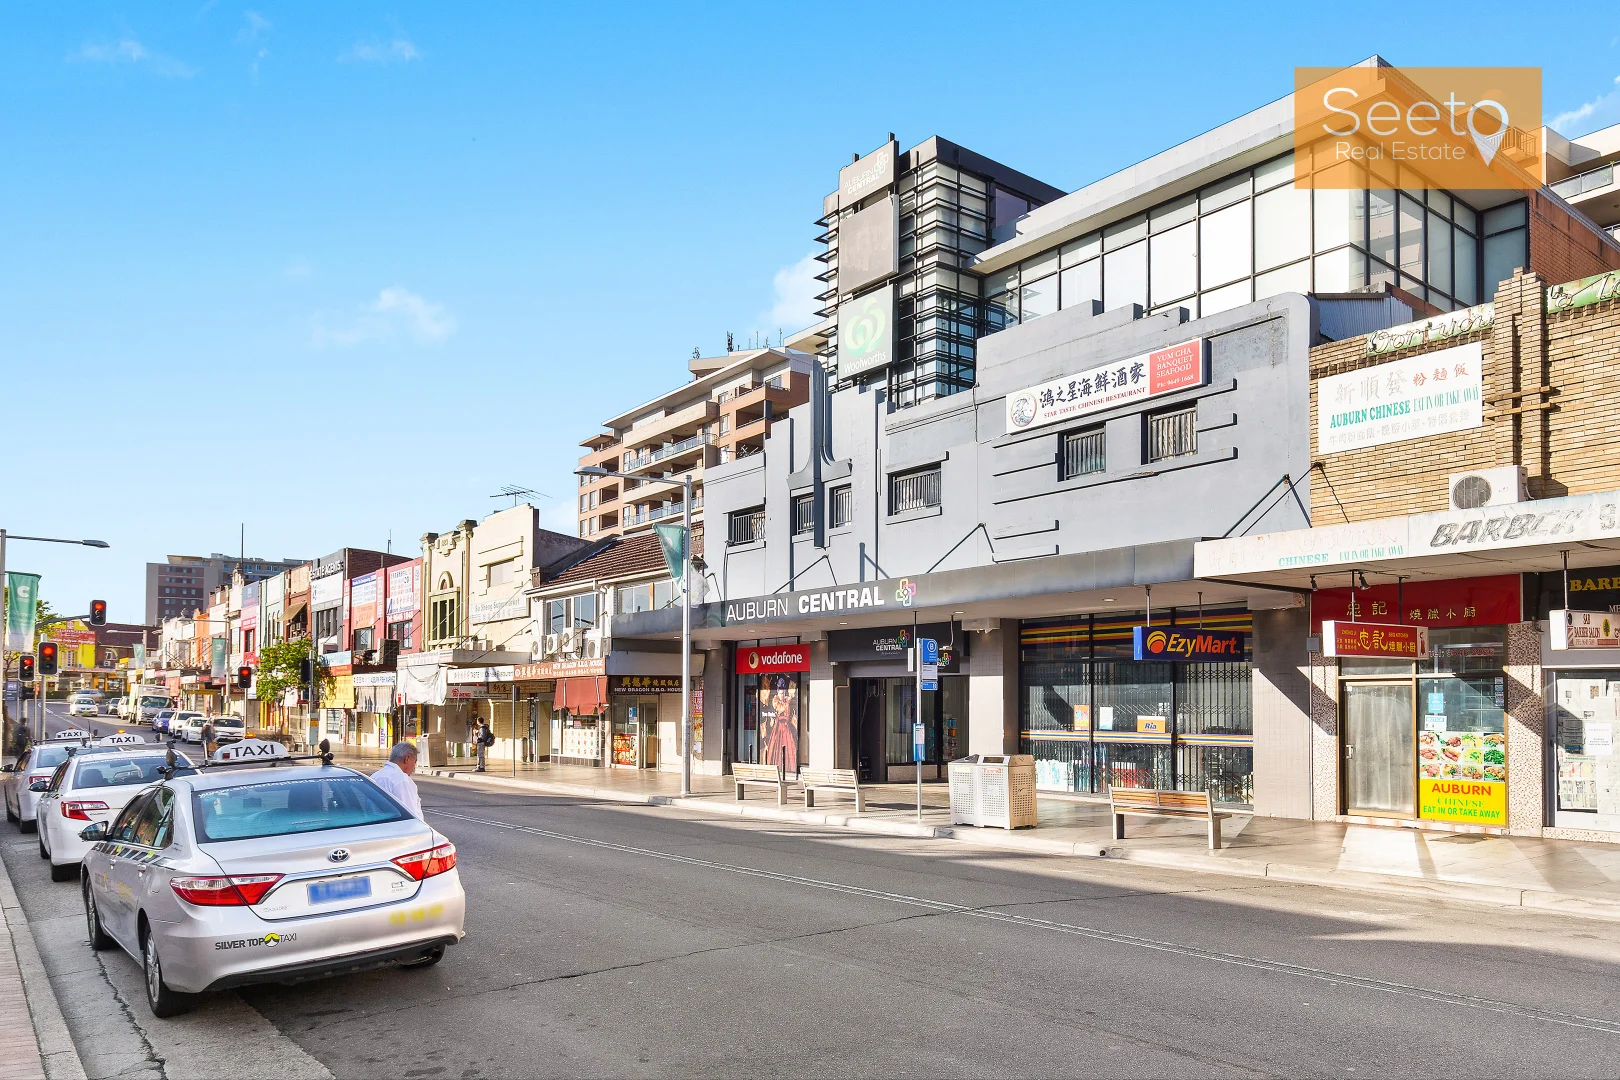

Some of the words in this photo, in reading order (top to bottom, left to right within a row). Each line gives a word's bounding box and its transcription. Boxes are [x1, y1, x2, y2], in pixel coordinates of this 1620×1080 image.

[846, 174, 880, 195] CENTRAL
[843, 350, 886, 374] Woolworths
[1156, 352, 1173, 363] YUM
[1175, 347, 1191, 358] CHA
[1157, 354, 1194, 370] BANQUET
[1156, 363, 1192, 378] SEAFOOD
[1039, 361, 1146, 408] 鴻之星海鮮酒家
[1043, 410, 1058, 419] STAR
[1059, 406, 1077, 415] TASTE
[1078, 399, 1105, 412] CHINESE
[1105, 387, 1147, 402] RESTAURANT
[1329, 407, 1368, 429] AUBURN
[1369, 399, 1411, 421] CHINESE
[1278, 553, 1329, 567] CHINESE
[1359, 549, 1369, 560] OR
[1370, 547, 1385, 559] TAKE
[726, 598, 788, 623] AUBURN
[798, 586, 885, 614] CENTRAL
[872, 638, 897, 646] AUBURN
[875, 644, 903, 652] CENTRAL
[1166, 633, 1236, 658] EzyMart
[761, 651, 803, 665] vodafone
[1144, 722, 1157, 730] Ria
[109, 735, 136, 744] TAXI
[231, 744, 276, 758] TAXI
[1431, 783, 1491, 796] AUBURN
[1437, 797, 1484, 807] CHINESE
[1423, 805, 1436, 813] EAT
[1438, 806, 1446, 815] IN
[1448, 807, 1458, 816] OR
[1459, 808, 1478, 817] TAKE
[1479, 809, 1500, 818] AWAY
[214, 940, 246, 950] SILVER
[246, 938, 265, 948] TOP
[278, 932, 297, 943] TAXI
